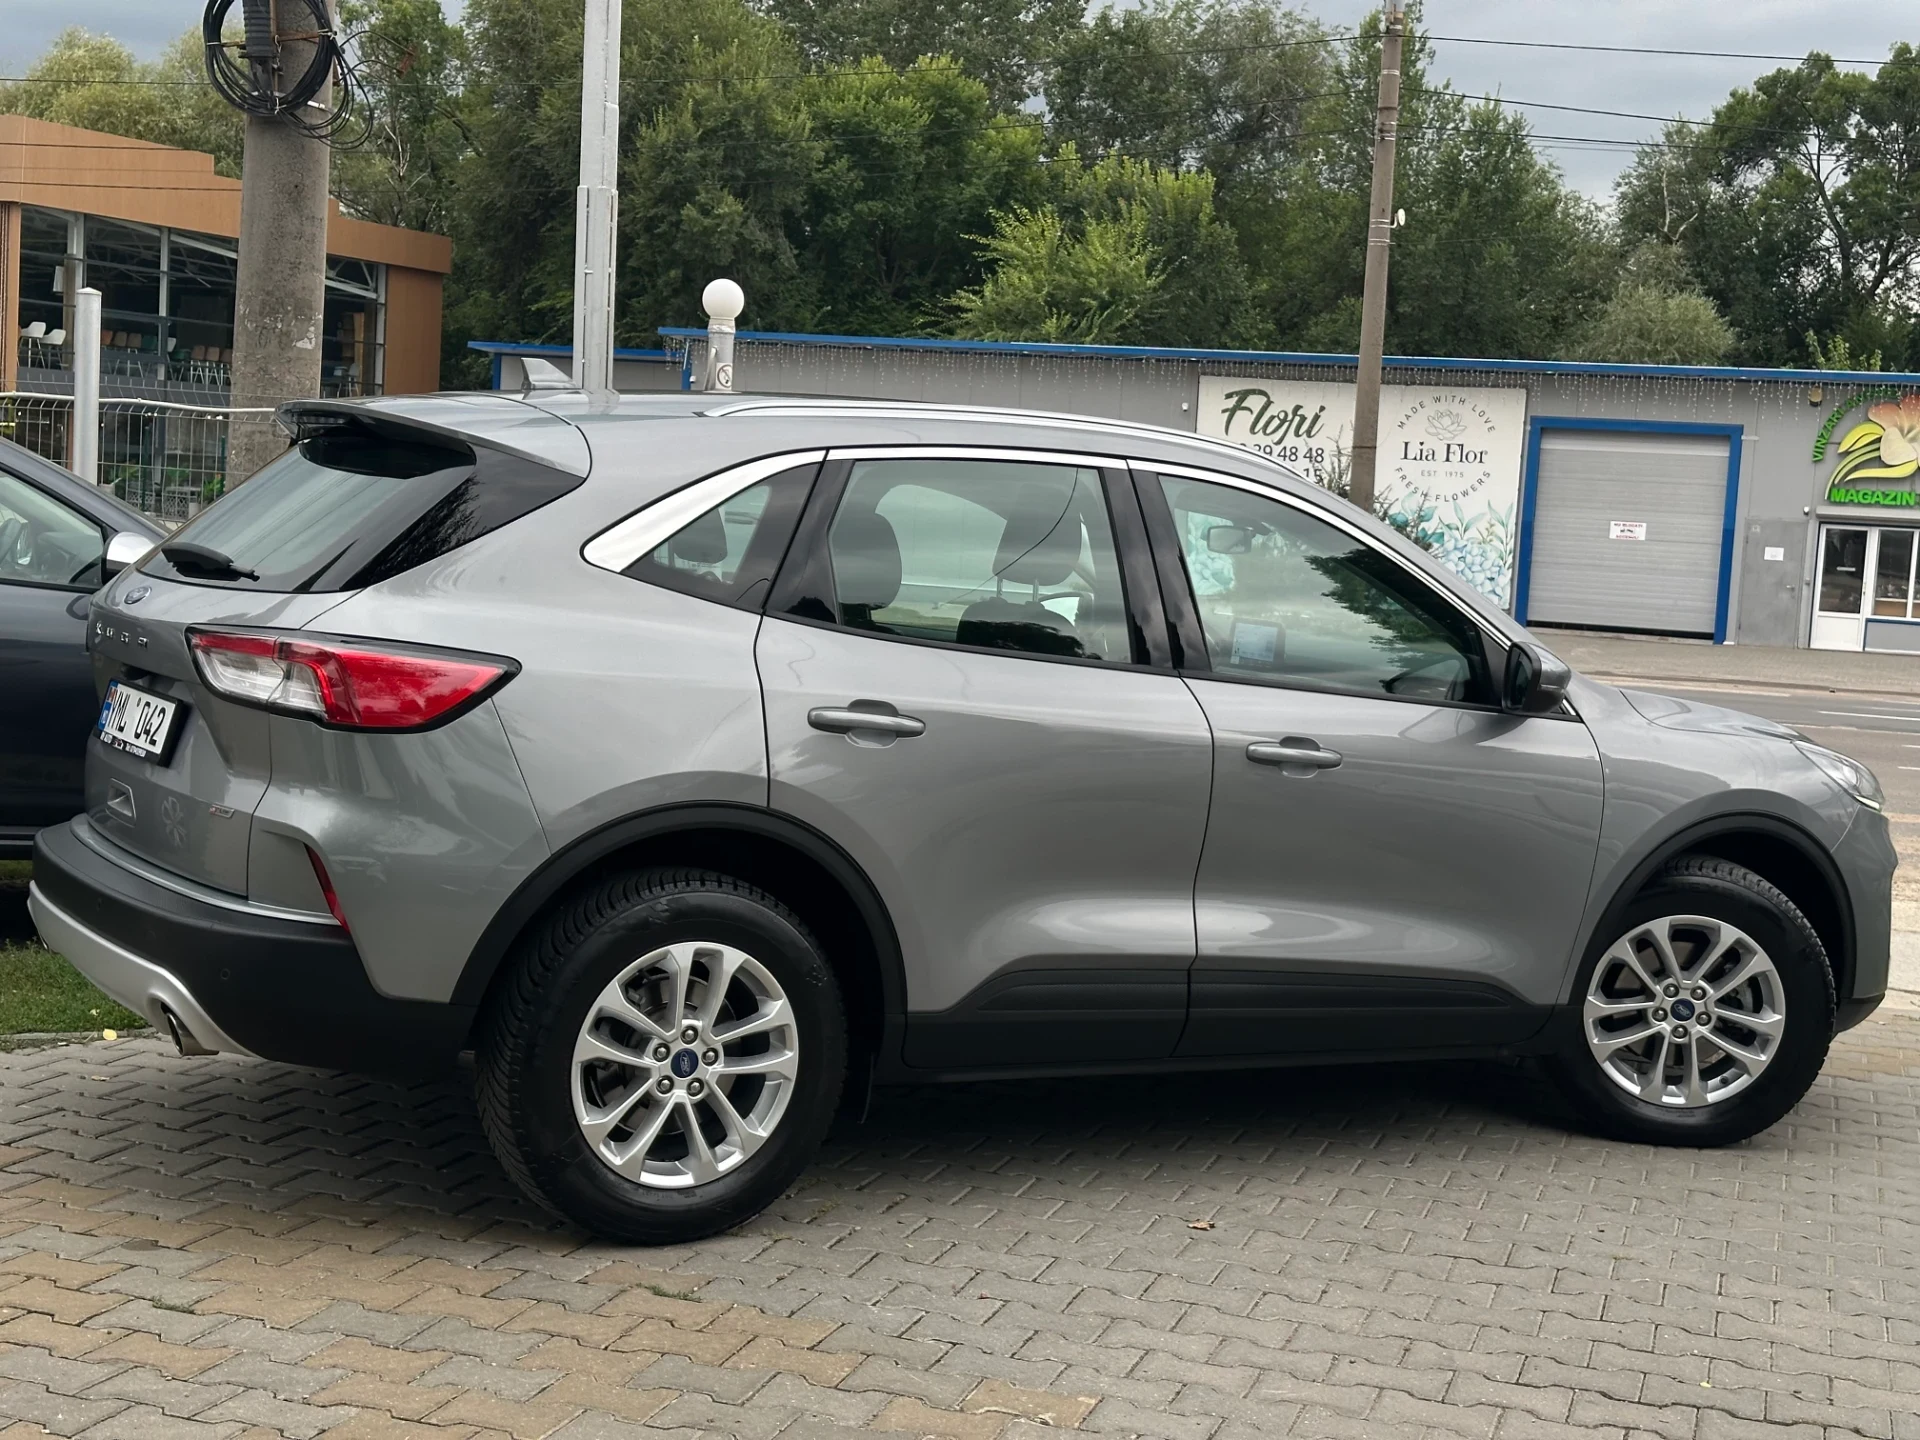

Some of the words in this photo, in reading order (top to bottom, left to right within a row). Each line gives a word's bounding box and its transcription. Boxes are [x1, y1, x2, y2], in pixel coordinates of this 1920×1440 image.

[1220, 388, 1326, 446] Flori
[1397, 400, 1426, 430] MADE
[1432, 395, 1466, 405] WITH
[1471, 403, 1496, 433] LOVE
[1277, 446, 1298, 462] 48
[1303, 447, 1324, 463] 48
[1400, 440, 1437, 462] Lia
[1442, 442, 1488, 464] Flor
[1394, 467, 1428, 498] FRESH
[1435, 470, 1491, 502] FLOWERS
[1421, 469, 1437, 477] EST
[1829, 488, 1916, 506] MAGAZIN
[134, 701, 166, 746] 042
